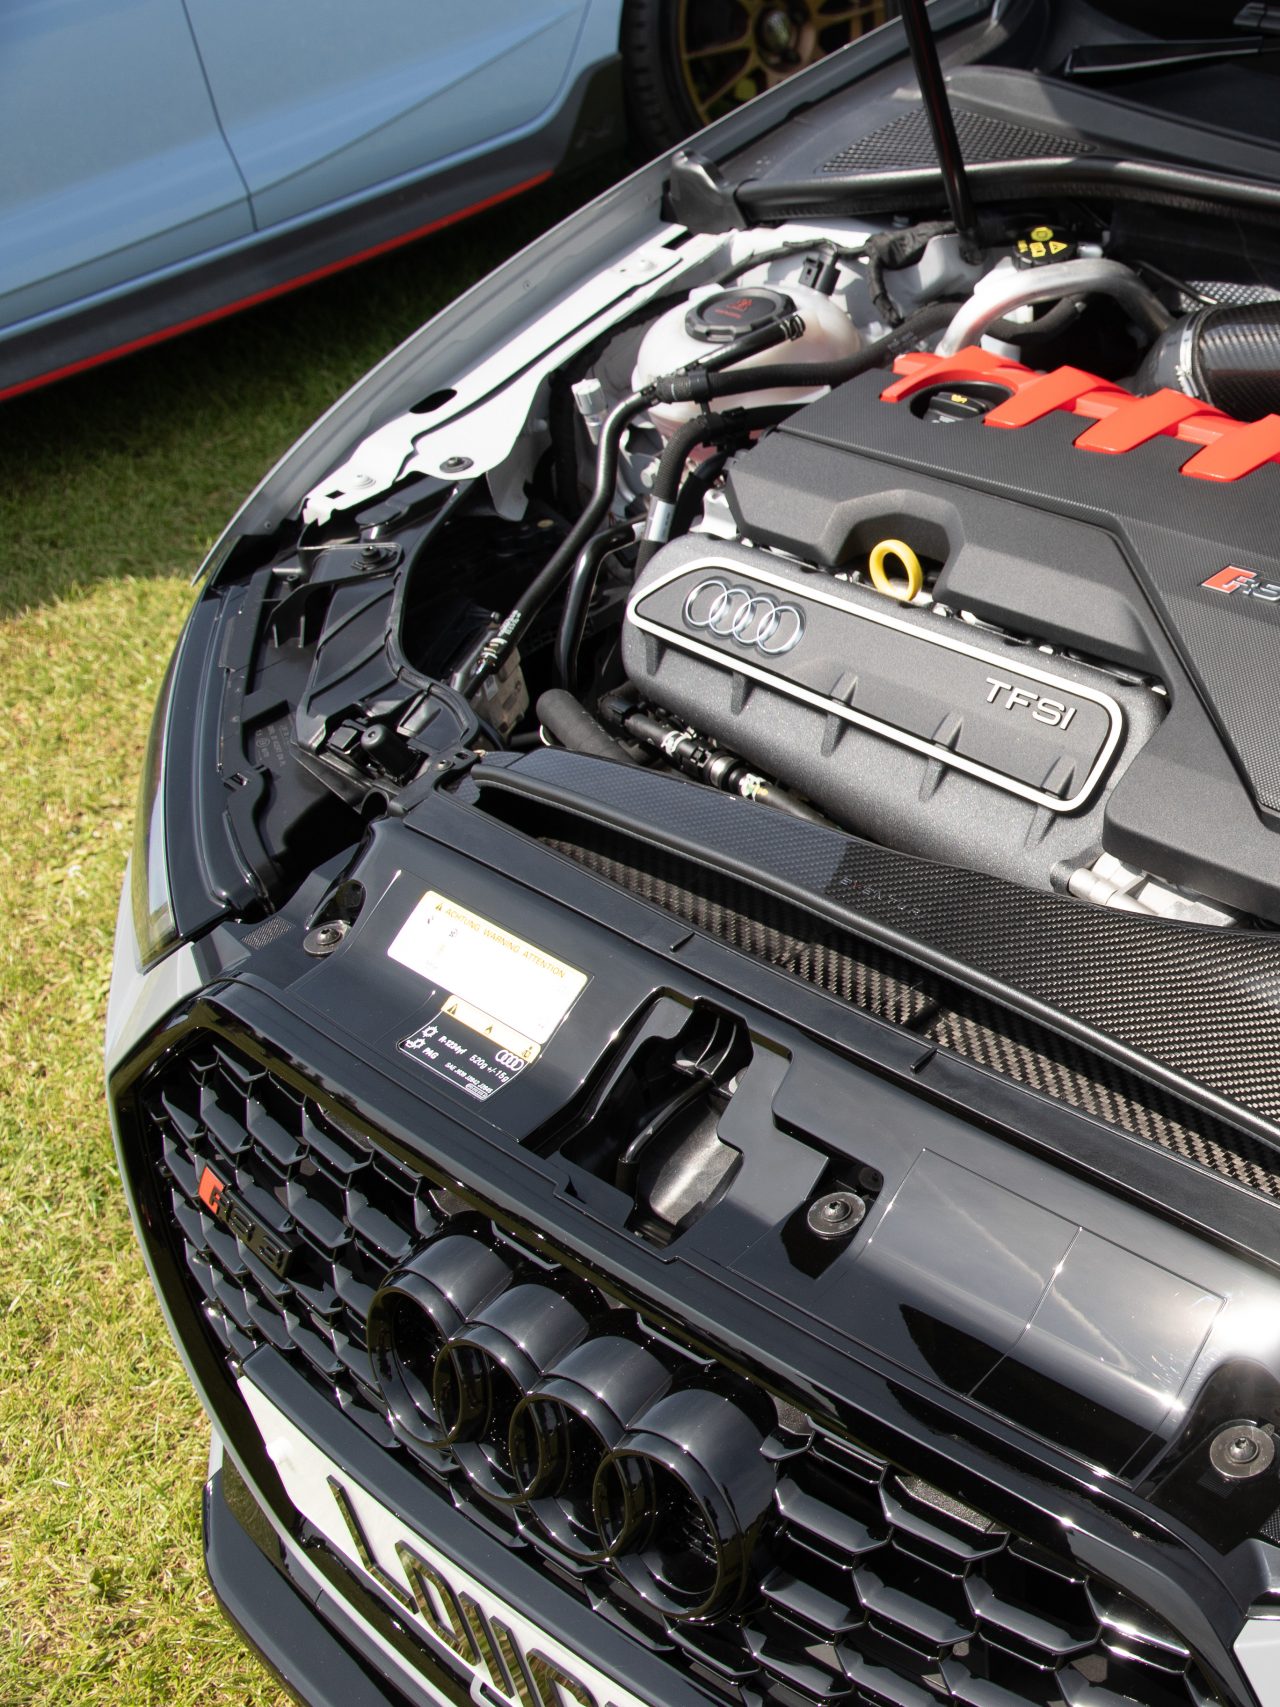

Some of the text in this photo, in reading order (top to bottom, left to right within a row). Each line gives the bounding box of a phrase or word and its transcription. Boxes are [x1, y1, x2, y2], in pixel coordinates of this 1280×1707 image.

[985, 676, 1078, 731] TFSI
[445, 907, 566, 978] ACHTUNG WARNING ATTENTION
[422, 1046, 439, 1060] PAG
[469, 1054, 488, 1070] 520g
